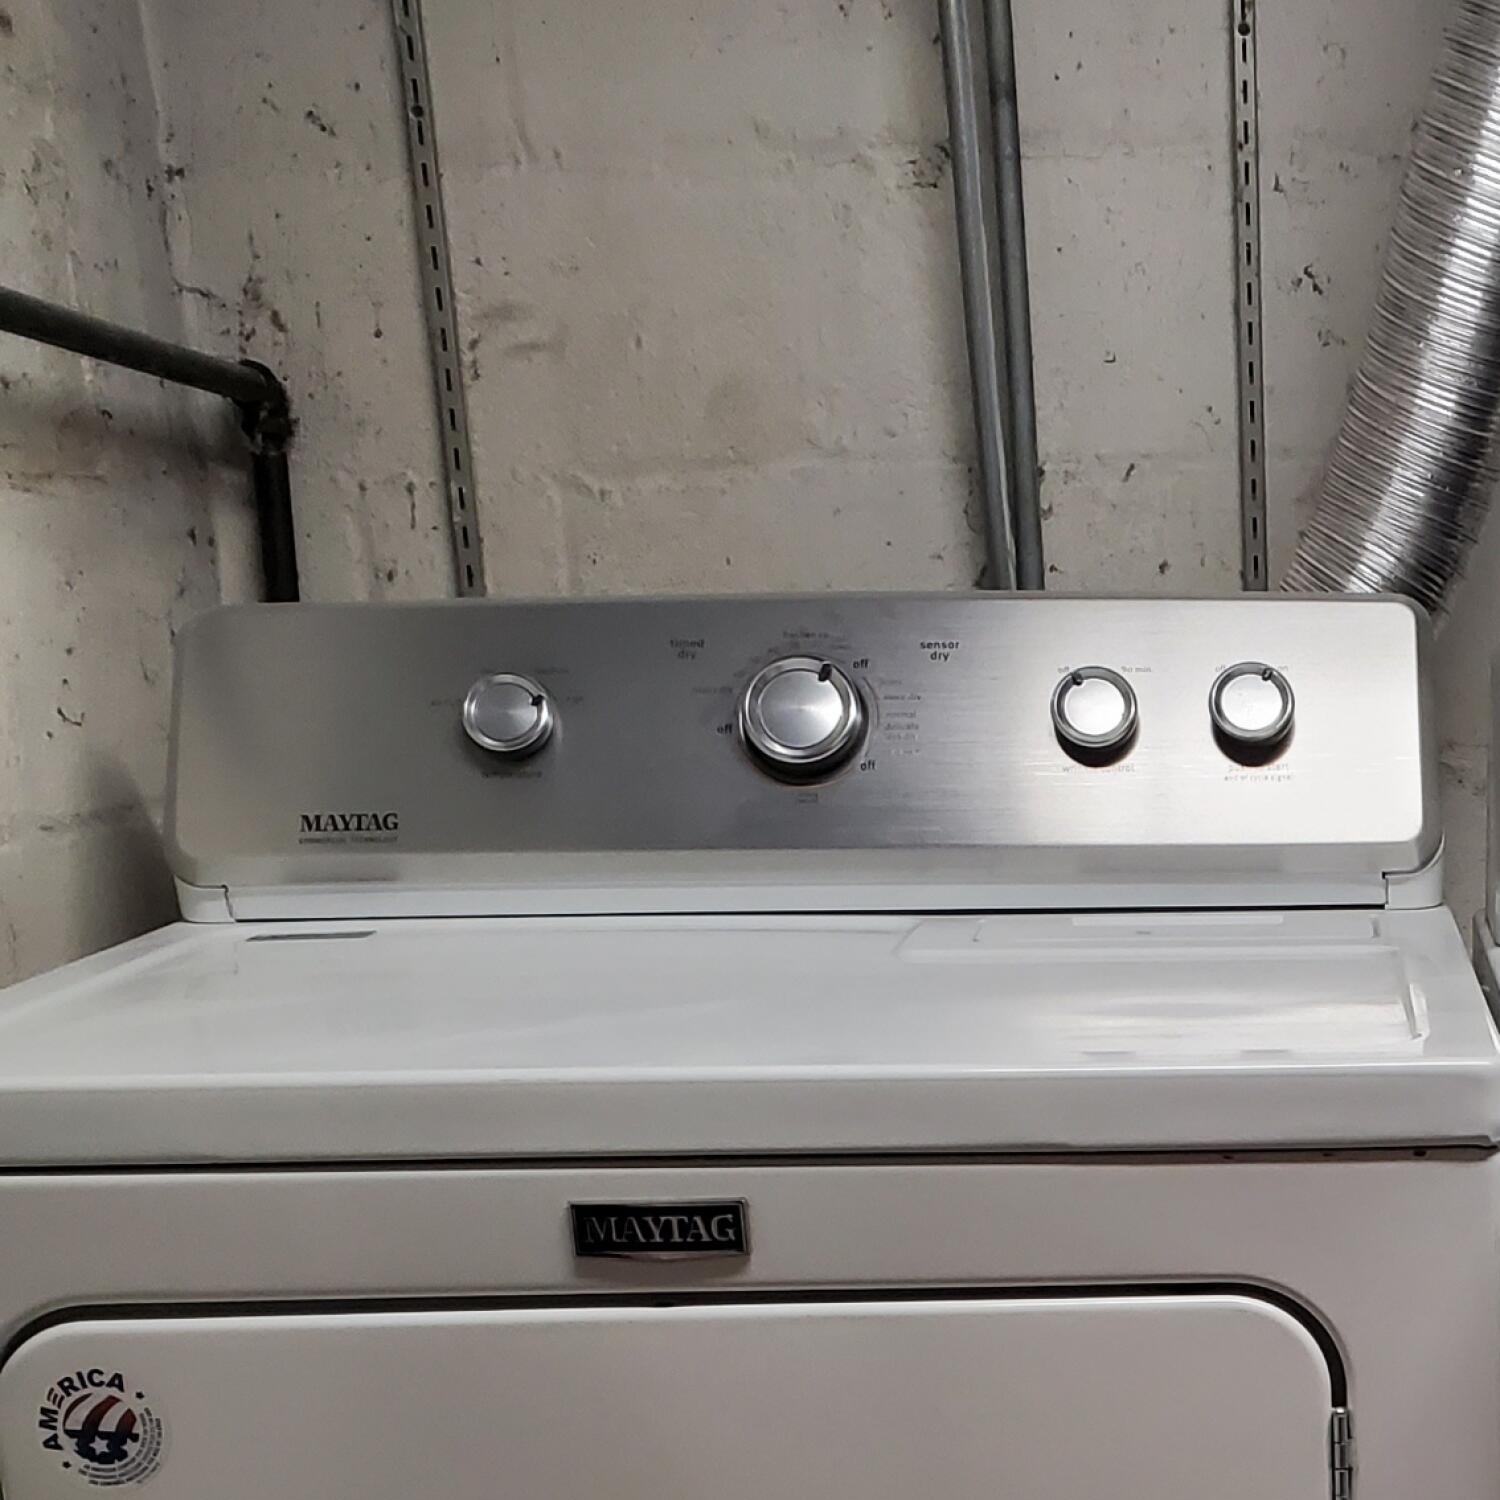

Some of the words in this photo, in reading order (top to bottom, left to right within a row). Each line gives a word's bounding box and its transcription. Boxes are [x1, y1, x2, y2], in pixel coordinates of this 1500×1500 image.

[920, 641, 960, 650] sensor
[929, 651, 950, 662] dry
[852, 658, 869, 669] off
[716, 723, 733, 734] off
[860, 759, 876, 771] off
[299, 812, 399, 833] MAYTAG
[584, 1213, 736, 1243] MAYTAG
[38, 1368, 125, 1451] AMERICA
